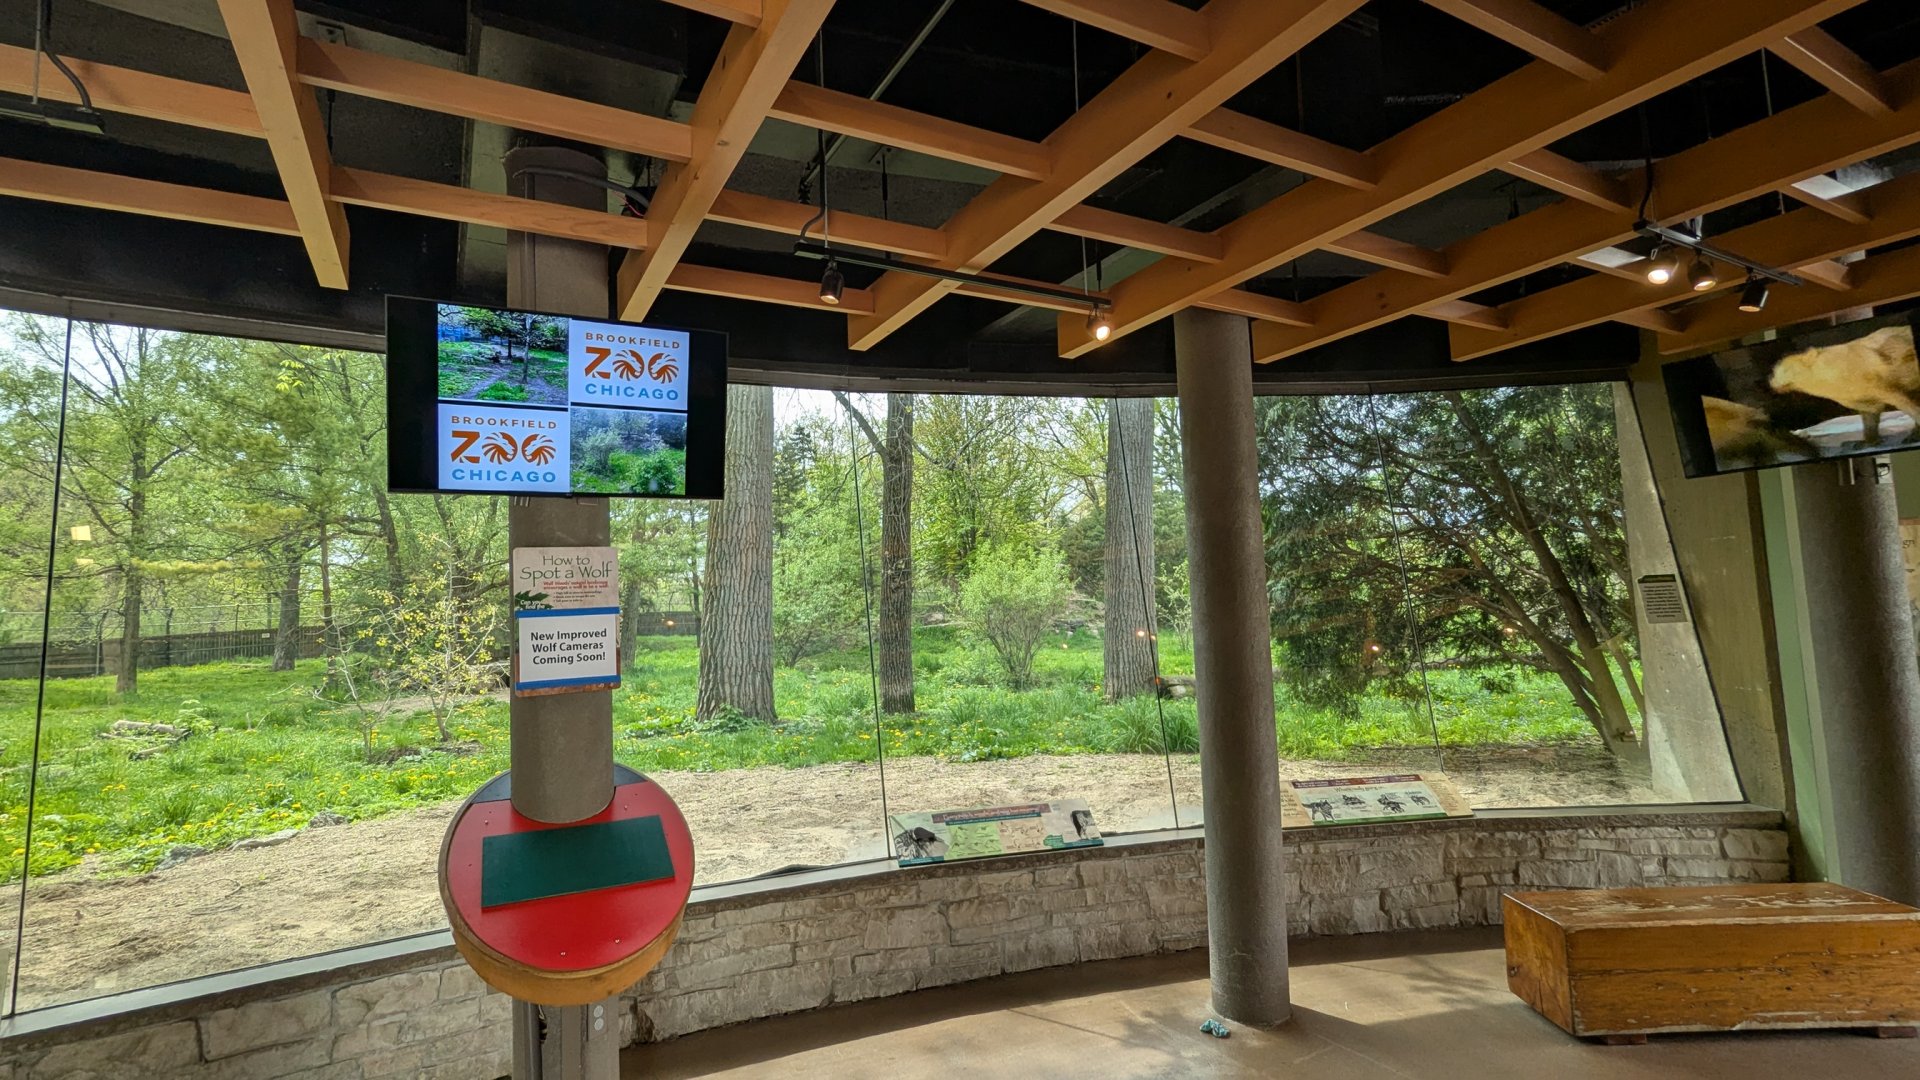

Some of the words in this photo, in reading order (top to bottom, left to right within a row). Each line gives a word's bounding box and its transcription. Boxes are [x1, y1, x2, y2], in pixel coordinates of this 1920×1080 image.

[585, 332, 680, 349] BROOKFIELD
[584, 346, 679, 384] ZOO
[585, 383, 679, 401] CHICAGO
[451, 415, 557, 429] BROOKFIELD
[450, 430, 557, 466] ZOO
[451, 468, 556, 483] CHICAGO
[542, 555, 573, 566] How
[576, 555, 590, 566] to
[519, 566, 560, 587] Spot
[564, 569, 574, 579] a
[578, 560, 613, 579] Wolf
[530, 632, 555, 641] New
[557, 628, 607, 641] Improved
[532, 642, 557, 653] Wolf
[559, 642, 604, 651] Cameras
[532, 654, 574, 665] Coming
[576, 652, 606, 662] Soon!
